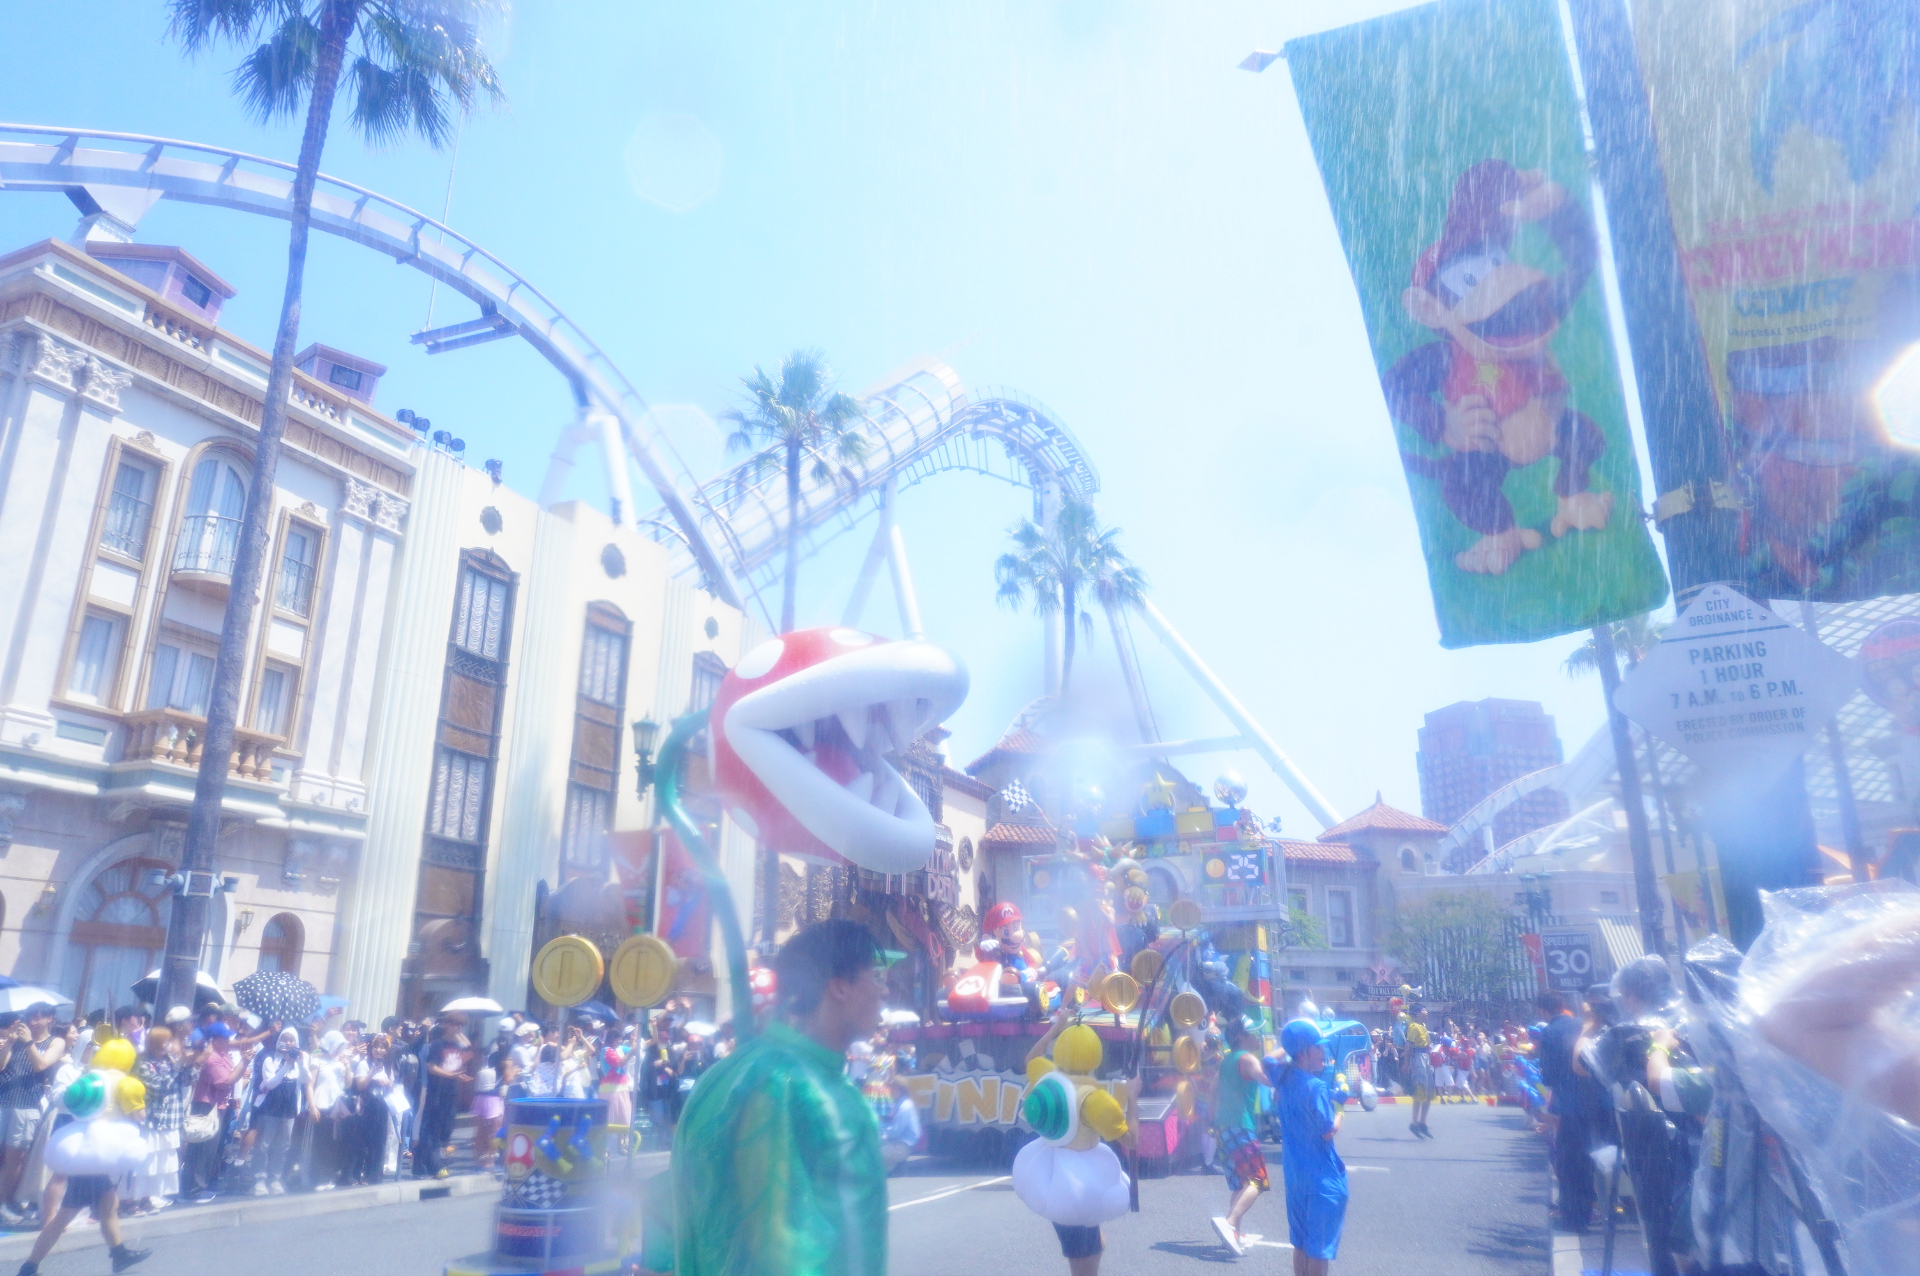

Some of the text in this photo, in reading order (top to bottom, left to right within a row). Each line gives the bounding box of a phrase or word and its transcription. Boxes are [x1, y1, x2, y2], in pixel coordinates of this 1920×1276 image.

[1728, 327, 1783, 338] UNIVERSAL
[1706, 598, 1730, 611] CITY
[1689, 609, 1753, 627] ORDINANCE
[1689, 641, 1767, 665] PARKING
[1700, 662, 1765, 685] 1 HOUR
[1670, 693, 1680, 709] 7
[1749, 683, 1762, 701] 6
[1766, 679, 1804, 698] P.M.
[1676, 715, 1727, 732] ERECTED
[1749, 708, 1788, 723] ORDER
[1791, 706, 1806, 719] OF
[1727, 721, 1805, 740] COMMISSION
[1227, 853, 1259, 880] 25
[1543, 936, 1590, 946] SPEED LIMIT
[1549, 949, 1591, 975] 30
[1560, 977, 1583, 987] MILES
